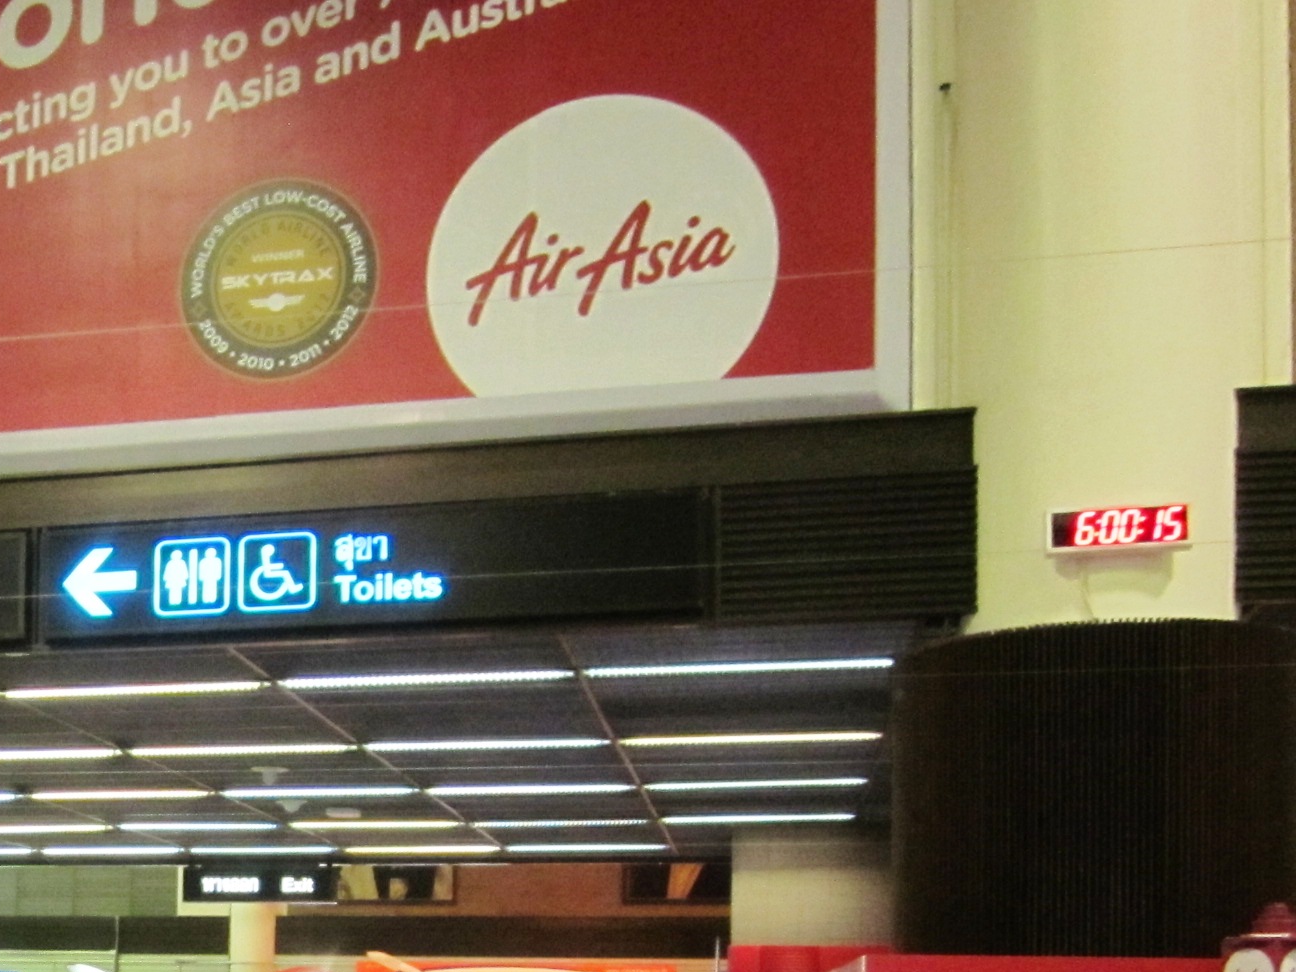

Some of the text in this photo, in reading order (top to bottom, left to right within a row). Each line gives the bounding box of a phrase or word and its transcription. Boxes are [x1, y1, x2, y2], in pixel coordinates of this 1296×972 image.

[109, 50, 189, 110] you
[202, 30, 248, 70] to
[206, 64, 301, 122] Asia
[314, 20, 400, 84] and
[191, 190, 368, 299] WORLD'S BEST LOW-COST AIRLINE
[221, 266, 335, 290] SKYTRAX
[198, 319, 229, 354] 2009
[237, 353, 274, 371] 2010
[289, 343, 322, 368] 2011
[330, 304, 359, 341] 2012
[333, 533, 389, 572] สุขา
[334, 570, 446, 604] Toilets
[281, 876, 314, 893] Exit
